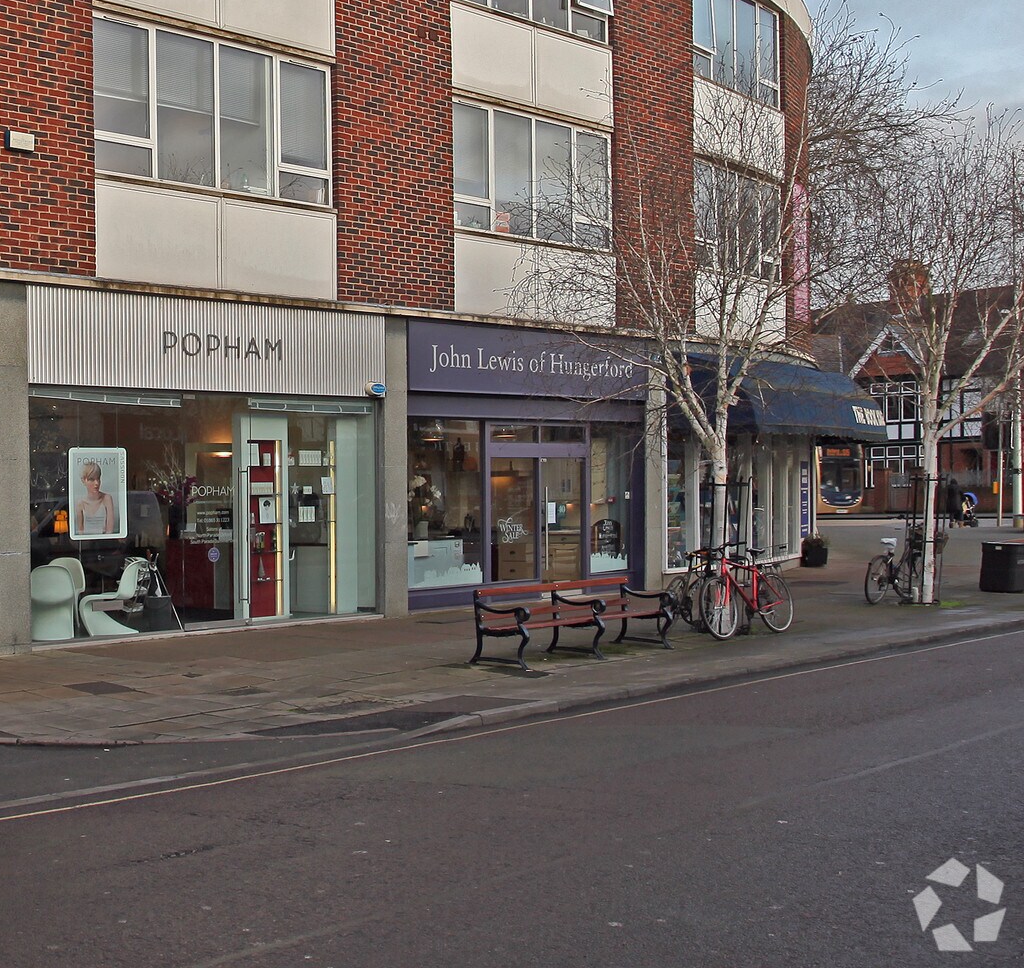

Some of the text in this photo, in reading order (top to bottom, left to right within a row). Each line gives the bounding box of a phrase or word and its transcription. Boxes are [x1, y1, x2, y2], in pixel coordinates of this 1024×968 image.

[163, 331, 283, 360] POPHAM
[429, 344, 634, 382] John Lewis of Hungerford
[77, 457, 116, 466] POPHAM
[191, 485, 235, 497] POPHAM
[497, 517, 528, 535] WINTER
[502, 532, 523, 543] SALE
